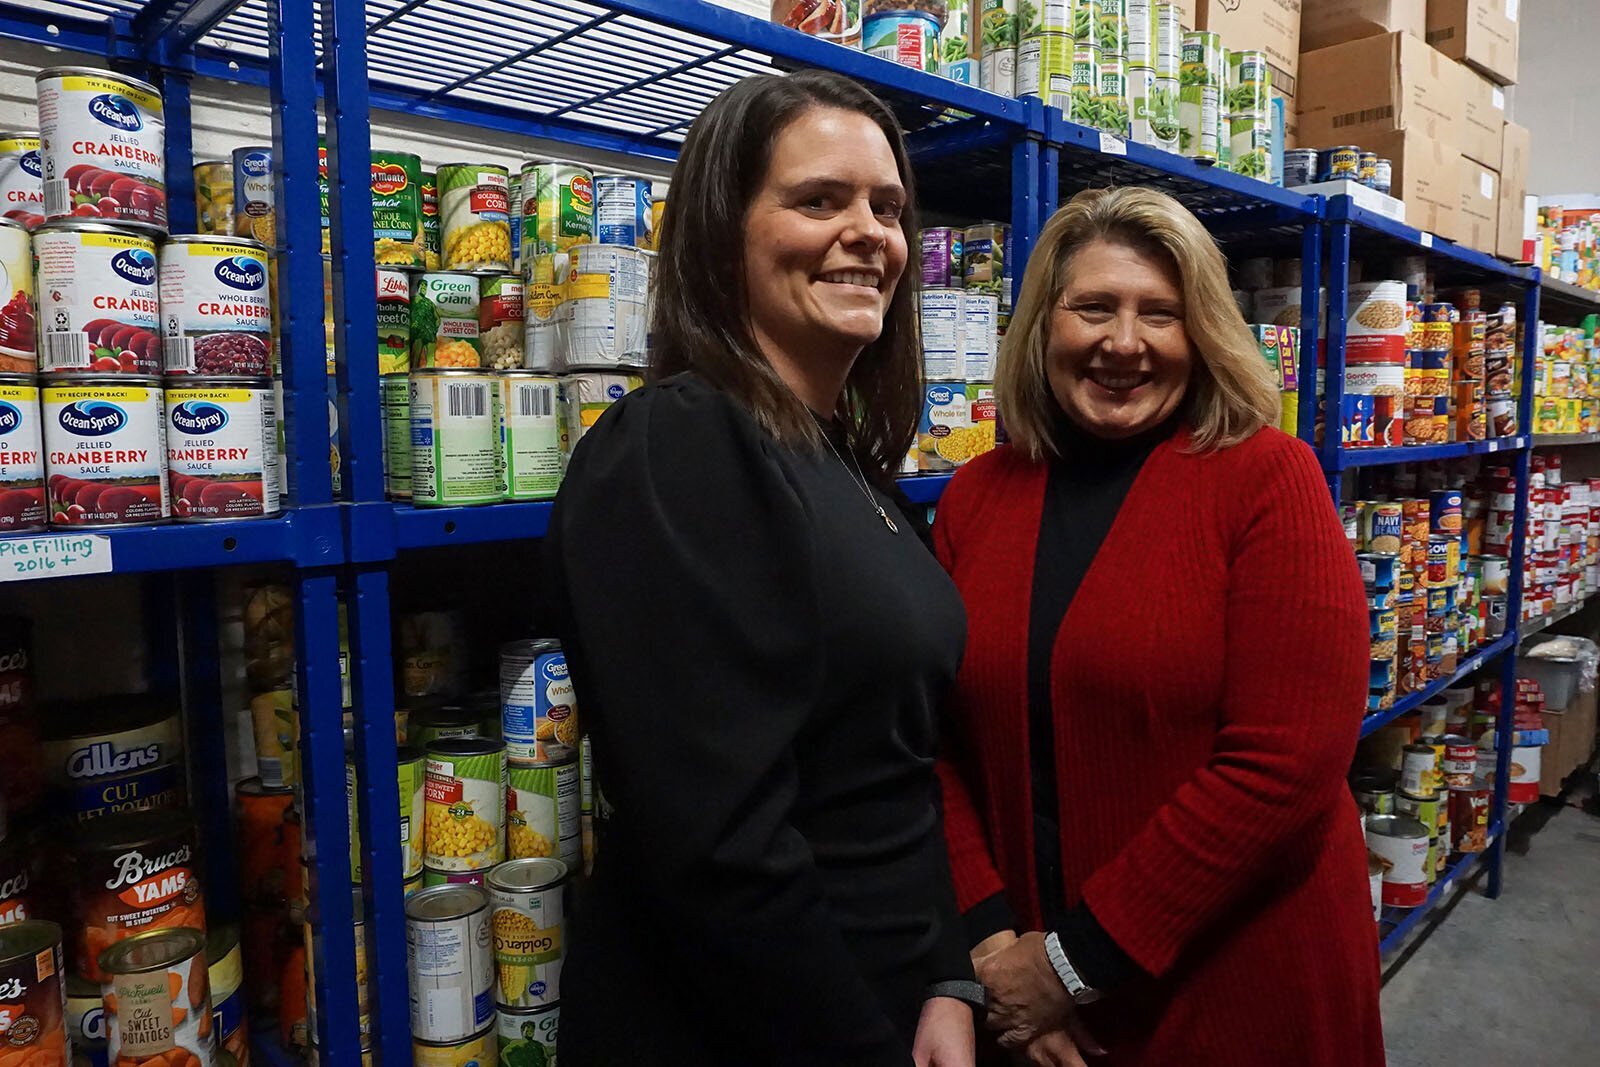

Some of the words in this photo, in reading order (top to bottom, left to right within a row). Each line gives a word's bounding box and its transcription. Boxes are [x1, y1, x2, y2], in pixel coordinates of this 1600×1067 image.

[952, 67, 964, 81] 12
[103, 83, 125, 94] RECIPE
[1102, 80, 1119, 88] REEN
[109, 134, 139, 146] JELLIED
[72, 141, 161, 168] CRANBERRY
[114, 159, 141, 170] SAUCE
[1360, 160, 1377, 168] BUSH
[377, 172, 405, 183] Monte
[486, 199, 507, 209] CORN
[372, 211, 400, 221] WHOLE
[390, 219, 412, 229] CORN
[116, 258, 142, 278] Ocean
[219, 265, 245, 284] Ocean
[245, 271, 263, 287] Spray
[431, 279, 471, 292] Green
[219, 294, 248, 303] WHOLE
[436, 291, 472, 305] Giant
[93, 296, 159, 314] CRANBER
[198, 303, 270, 319] CRANBERR
[134, 314, 154, 322] SAUCE
[236, 318, 258, 327] SAUCE
[1281, 329, 1289, 346] 4
[929, 390, 950, 398] Great
[0, 411, 15, 427] ray
[62, 411, 90, 429] Ocean
[91, 412, 119, 431] Spray
[173, 411, 196, 428] Ocean
[195, 412, 221, 430] Spray
[75, 441, 112, 450] JELLIED
[50, 450, 147, 465] CRANBERRY
[80, 466, 111, 474] SAUCE
[187, 462, 213, 470] SAUCE
[1377, 516, 1400, 526] NAVY
[1374, 525, 1400, 536] BEANS
[0, 543, 29, 557] Pie
[32, 538, 93, 558] Filling
[14, 556, 56, 573] 2016
[551, 685, 573, 697] Whol
[102, 781, 139, 804] CUT
[434, 783, 455, 793] SWEET
[105, 845, 192, 890] Bruce's
[133, 871, 187, 904] YAMS
[0, 903, 27, 925] MS
[106, 915, 118, 923] CUT
[119, 912, 141, 922] SWEET
[141, 904, 170, 919] POTATOES
[132, 916, 153, 927] SYRUP
[492, 936, 503, 950] Co
[506, 937, 553, 953] Golden
[132, 1009, 153, 1019] Cut
[128, 1017, 160, 1032] SWEET
[122, 1028, 170, 1045] POTATOES
